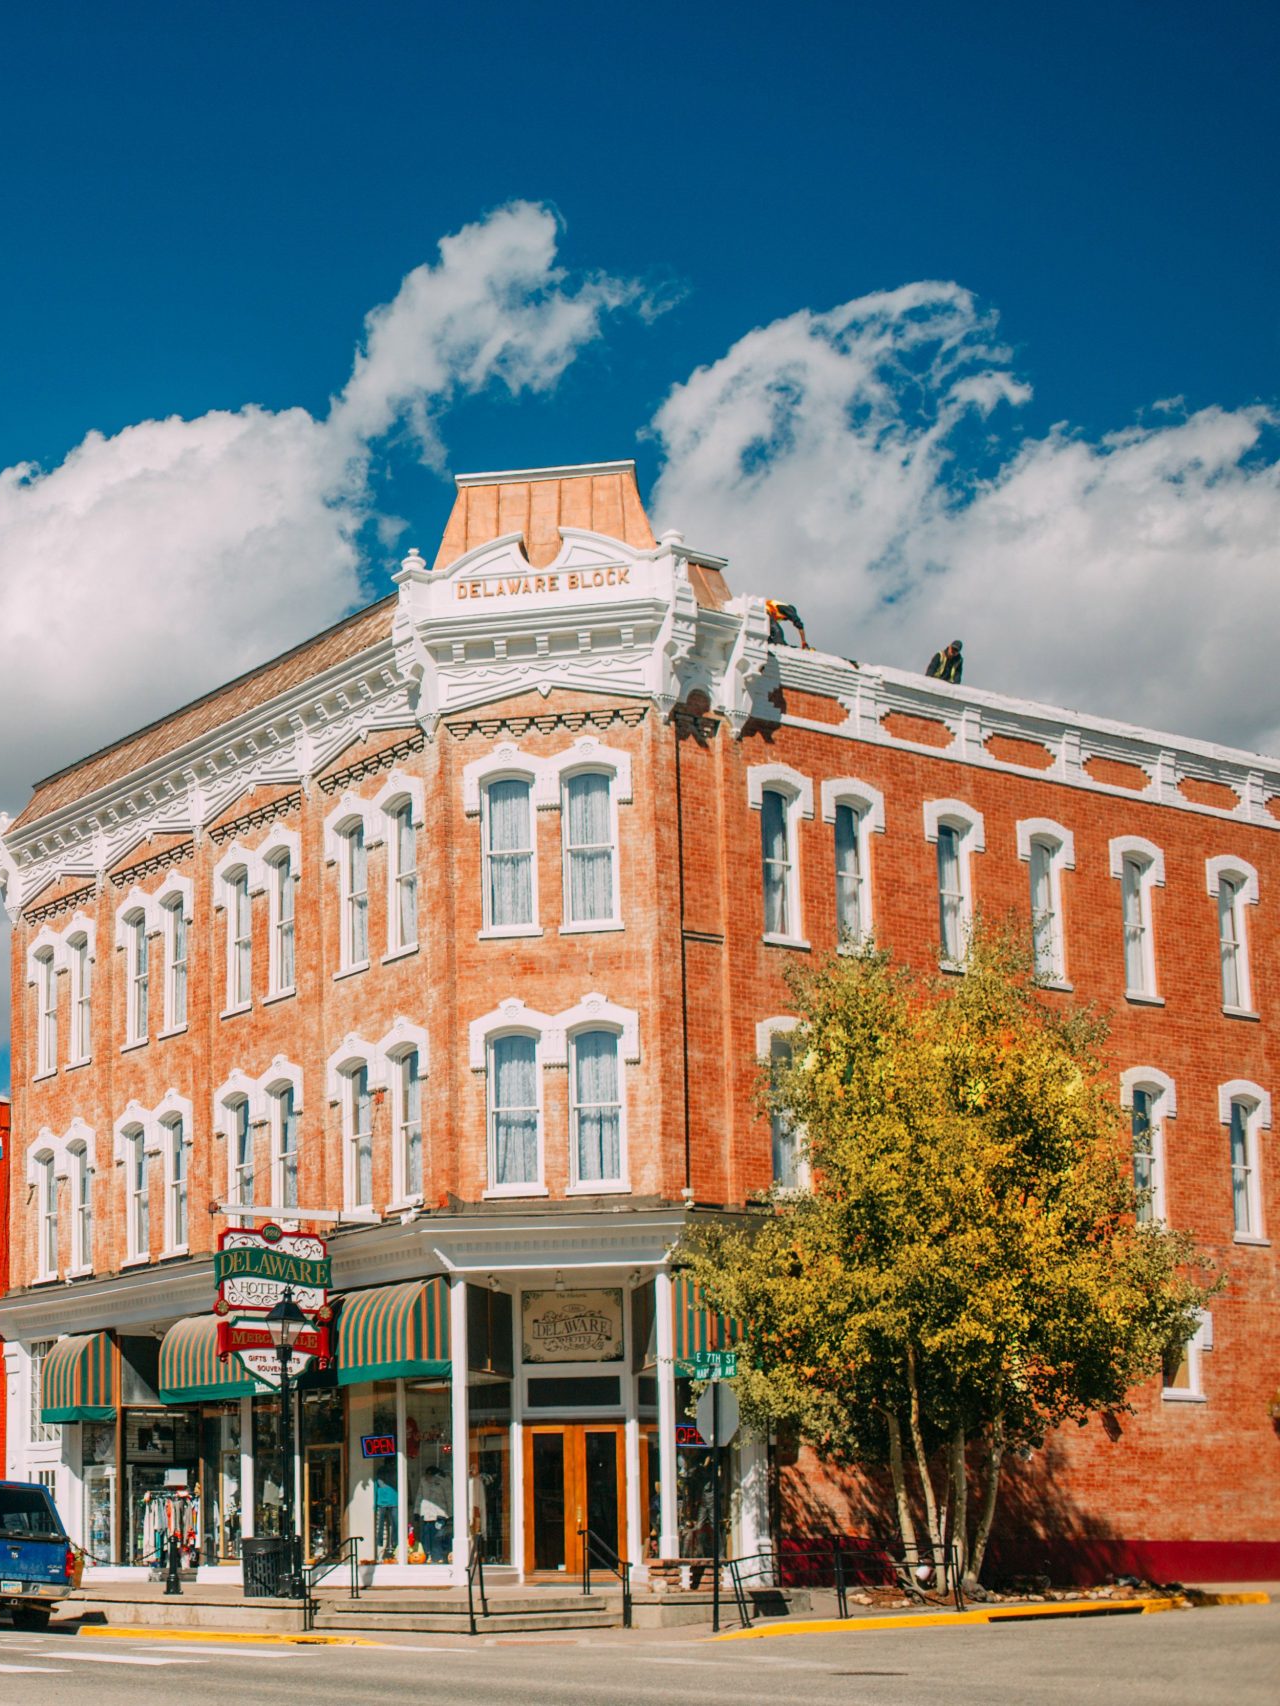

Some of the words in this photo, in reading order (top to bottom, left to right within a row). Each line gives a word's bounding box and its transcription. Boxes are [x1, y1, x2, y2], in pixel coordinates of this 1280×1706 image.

[457, 575, 560, 600] DELAWARE
[567, 568, 630, 590] BLOCK
[220, 1250, 329, 1285] DELAWARE
[240, 1281, 281, 1296] HOTEL
[536, 1319, 608, 1337] DELAWARE
[248, 1354, 267, 1363] GIFTS
[696, 1352, 702, 1363] E
[706, 1352, 721, 1364] 7TH
[725, 1353, 736, 1365] ST
[676, 1427, 705, 1445] OPE
[365, 1438, 396, 1455] OPEN
